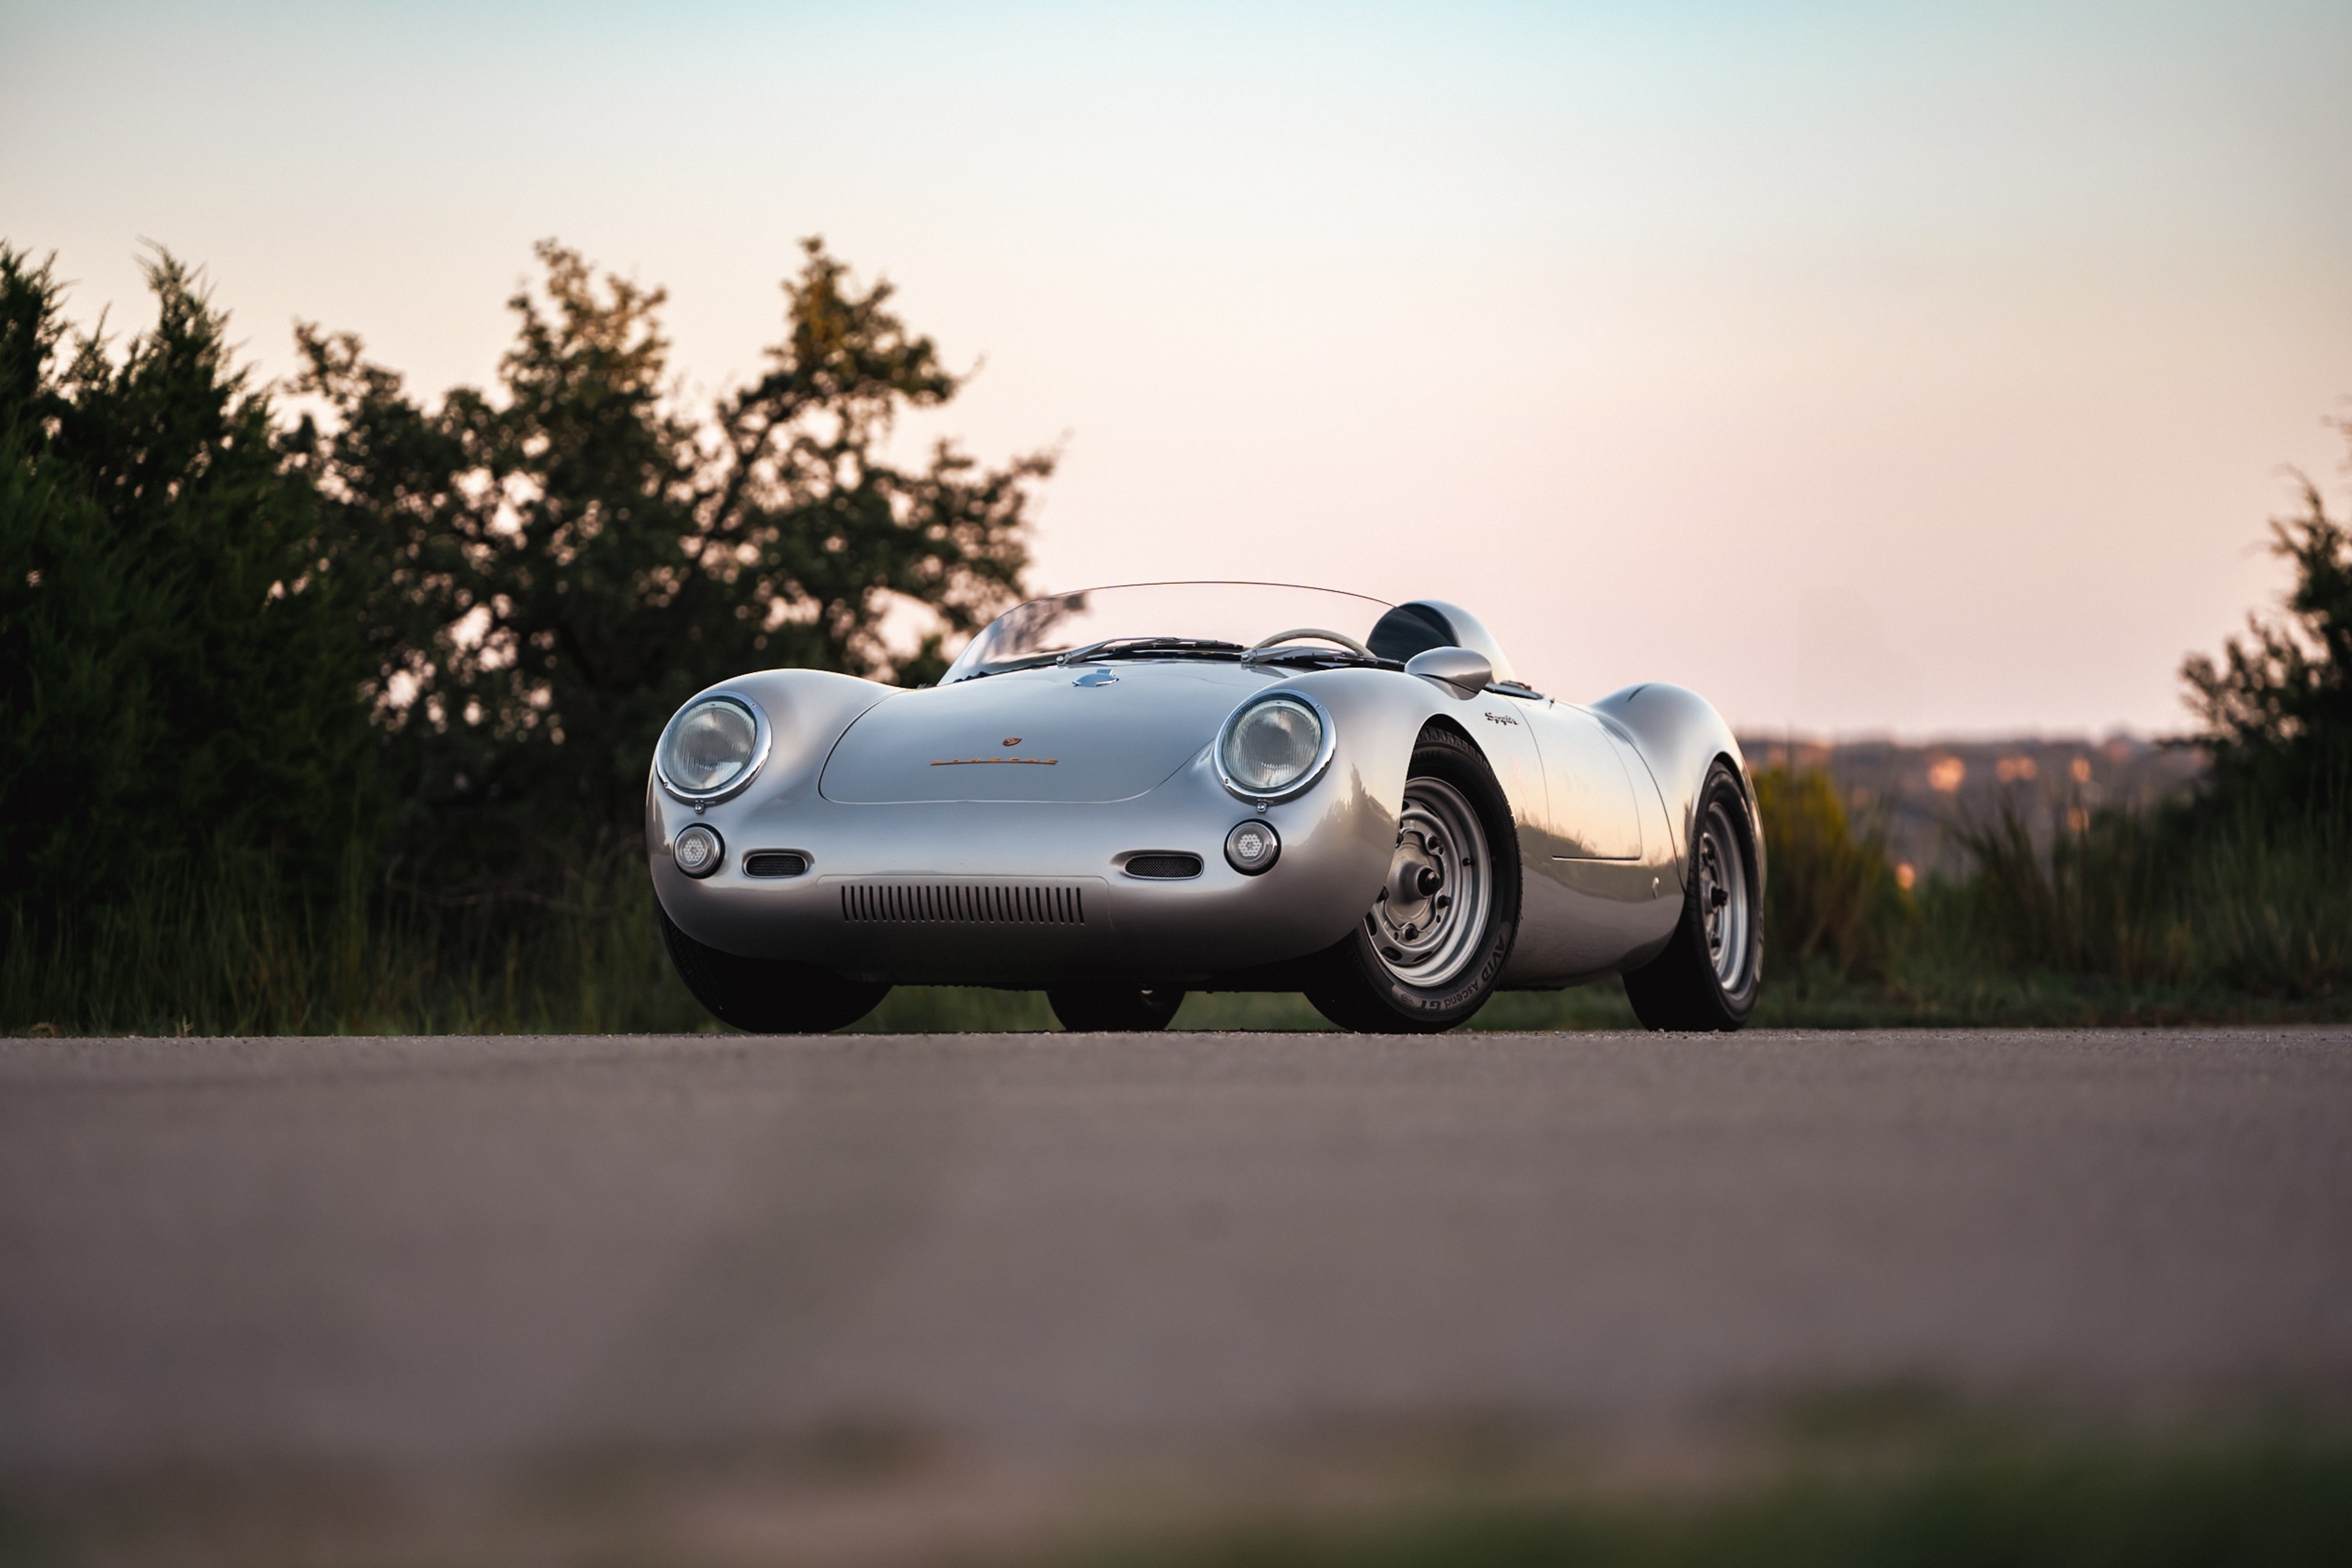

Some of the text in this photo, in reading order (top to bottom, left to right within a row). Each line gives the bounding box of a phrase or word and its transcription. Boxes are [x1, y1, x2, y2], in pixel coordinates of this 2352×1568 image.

[1417, 934, 1505, 1011] AVID Ascend GT
